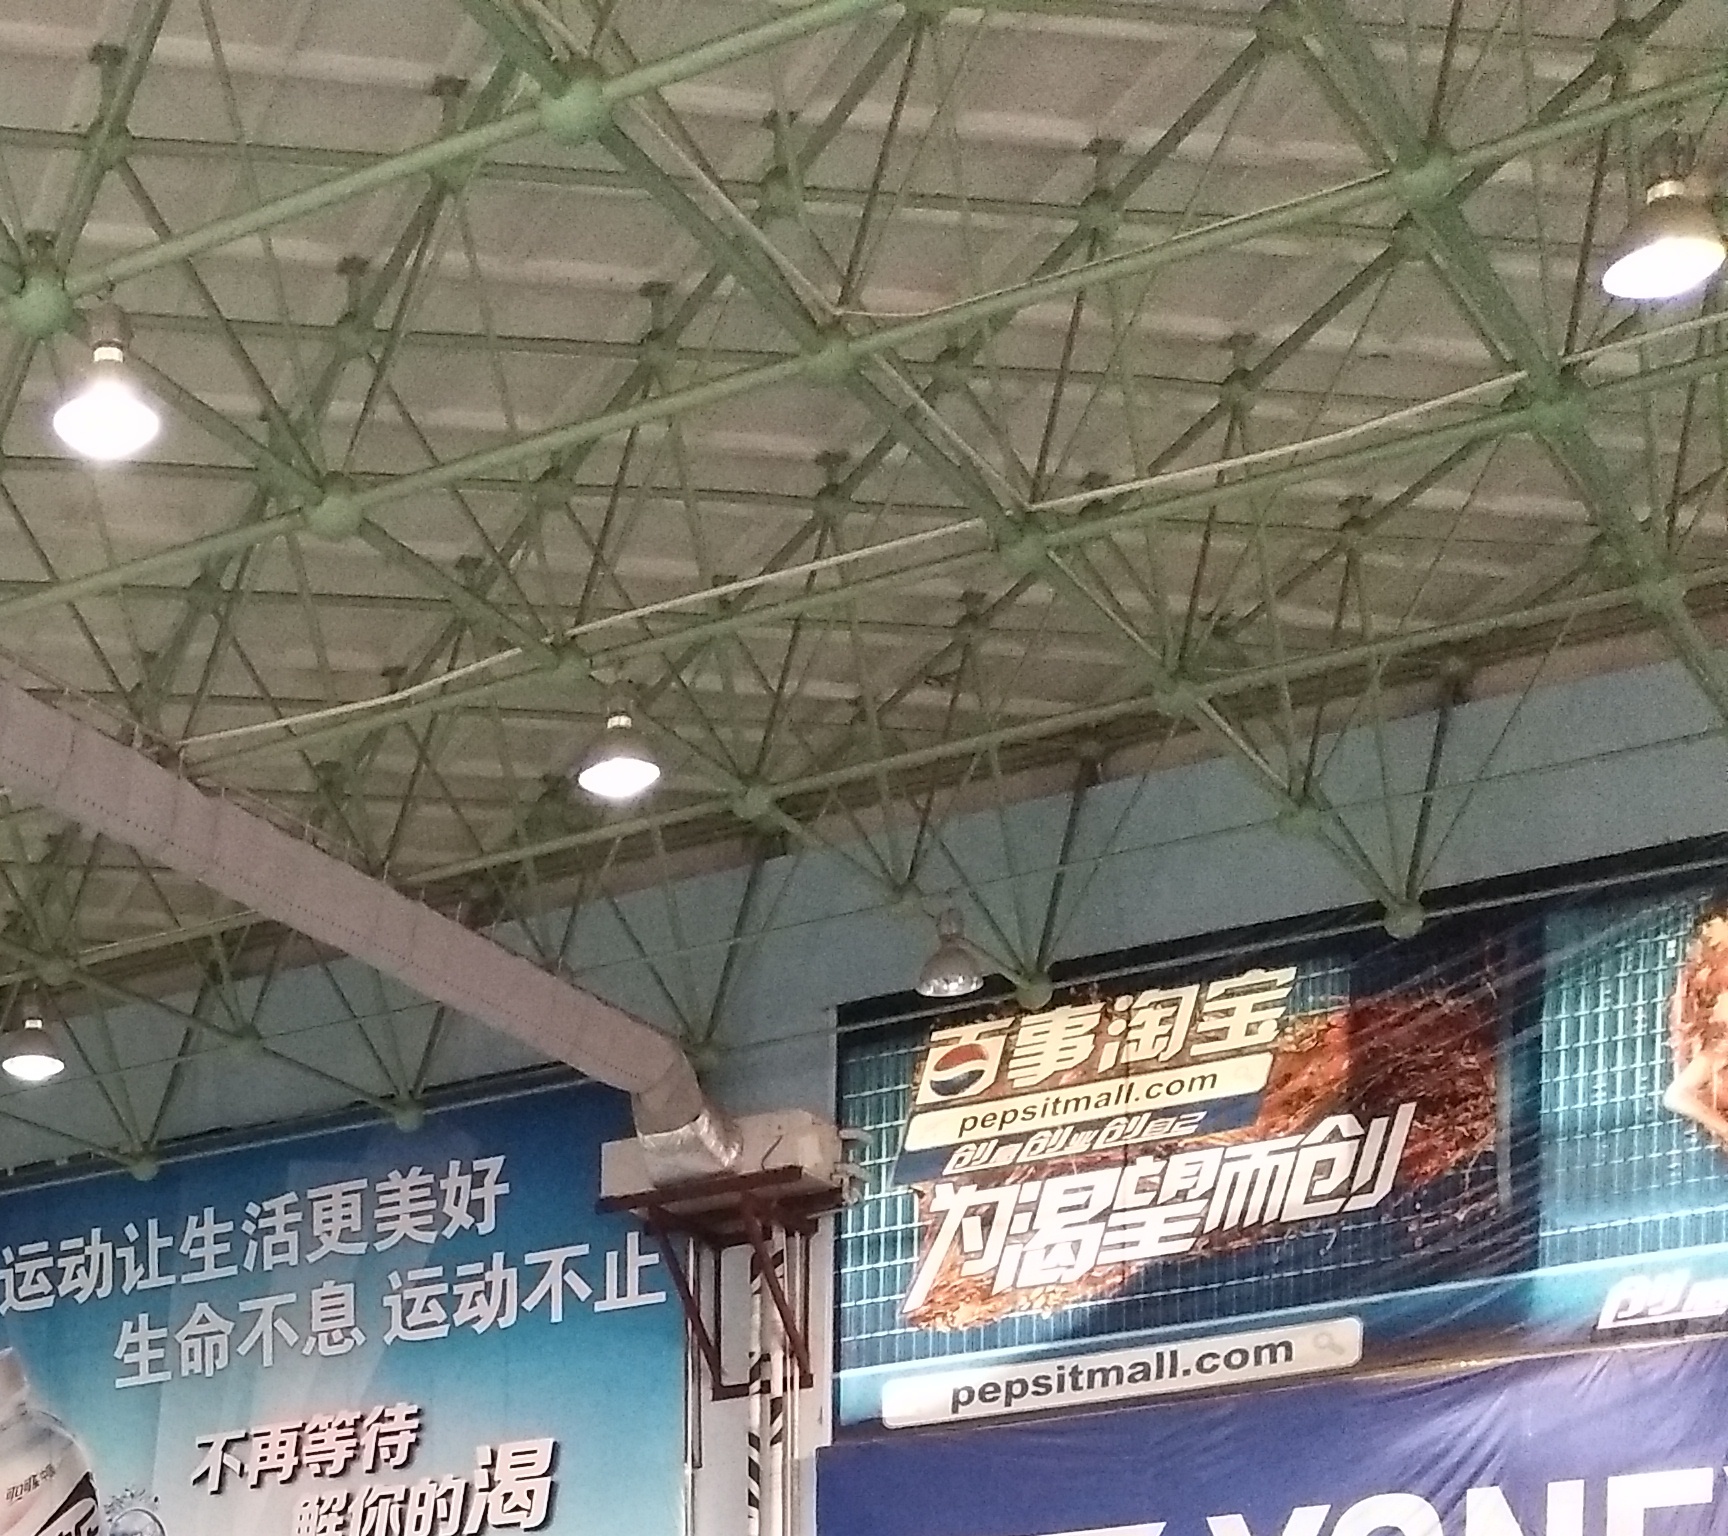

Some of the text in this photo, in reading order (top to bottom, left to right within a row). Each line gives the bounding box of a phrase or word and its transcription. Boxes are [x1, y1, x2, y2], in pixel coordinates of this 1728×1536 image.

[915, 966, 1297, 1105] 百事淘宝
[958, 1072, 1218, 1138] pepsitmall.com
[114, 1229, 668, 1391] 生命不息 运动不止
[950, 1333, 1293, 1415] pepsitmall.com
[191, 1402, 422, 1496] 不再等待
